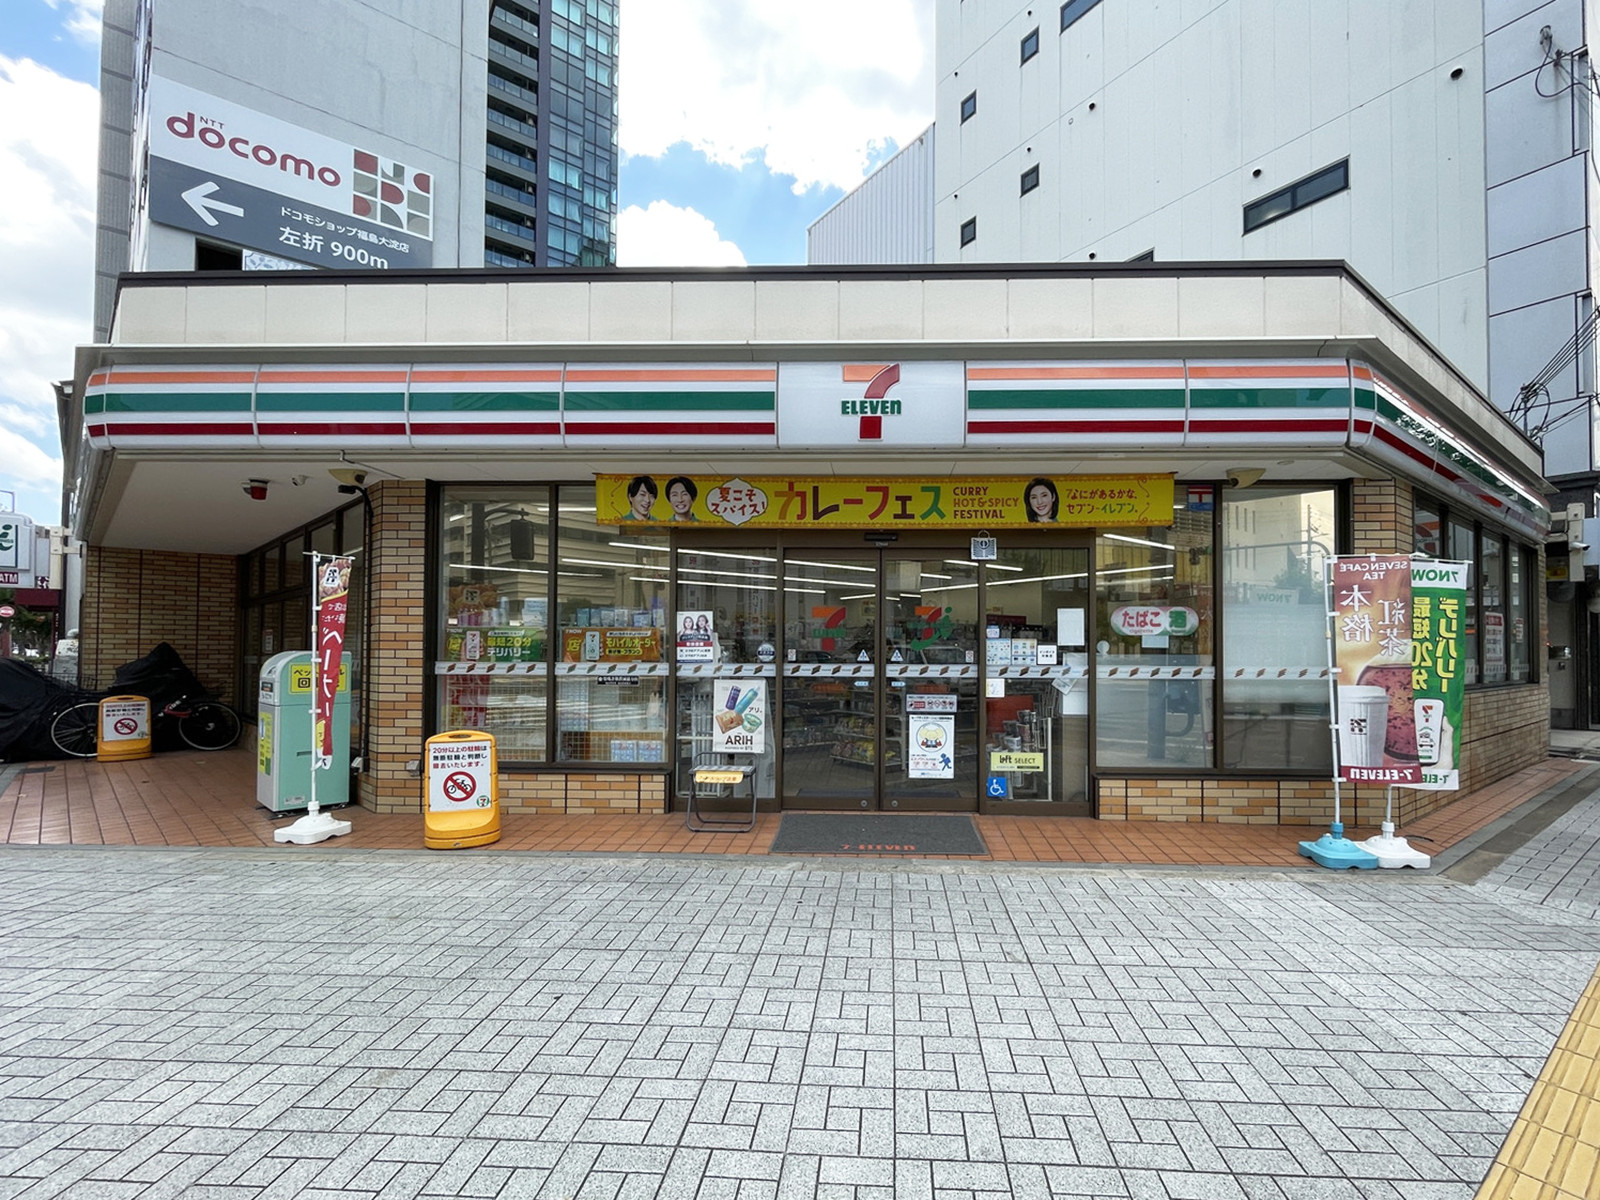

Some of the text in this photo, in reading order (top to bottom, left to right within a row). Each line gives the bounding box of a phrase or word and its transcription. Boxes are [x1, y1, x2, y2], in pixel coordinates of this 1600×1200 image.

[200, 116, 225, 130] NTT
[166, 111, 341, 187] docomo
[281, 205, 409, 253] ドコモショップ福島大淀店
[279, 225, 388, 269] 左折 900m
[718, 486, 756, 502] 夏こそ
[953, 486, 989, 496] CURRY
[774, 481, 945, 521] カレーフェス
[953, 509, 1005, 519] FESTIVAL
[1122, 610, 1161, 627] たばこ
[725, 735, 753, 745] ARIH
